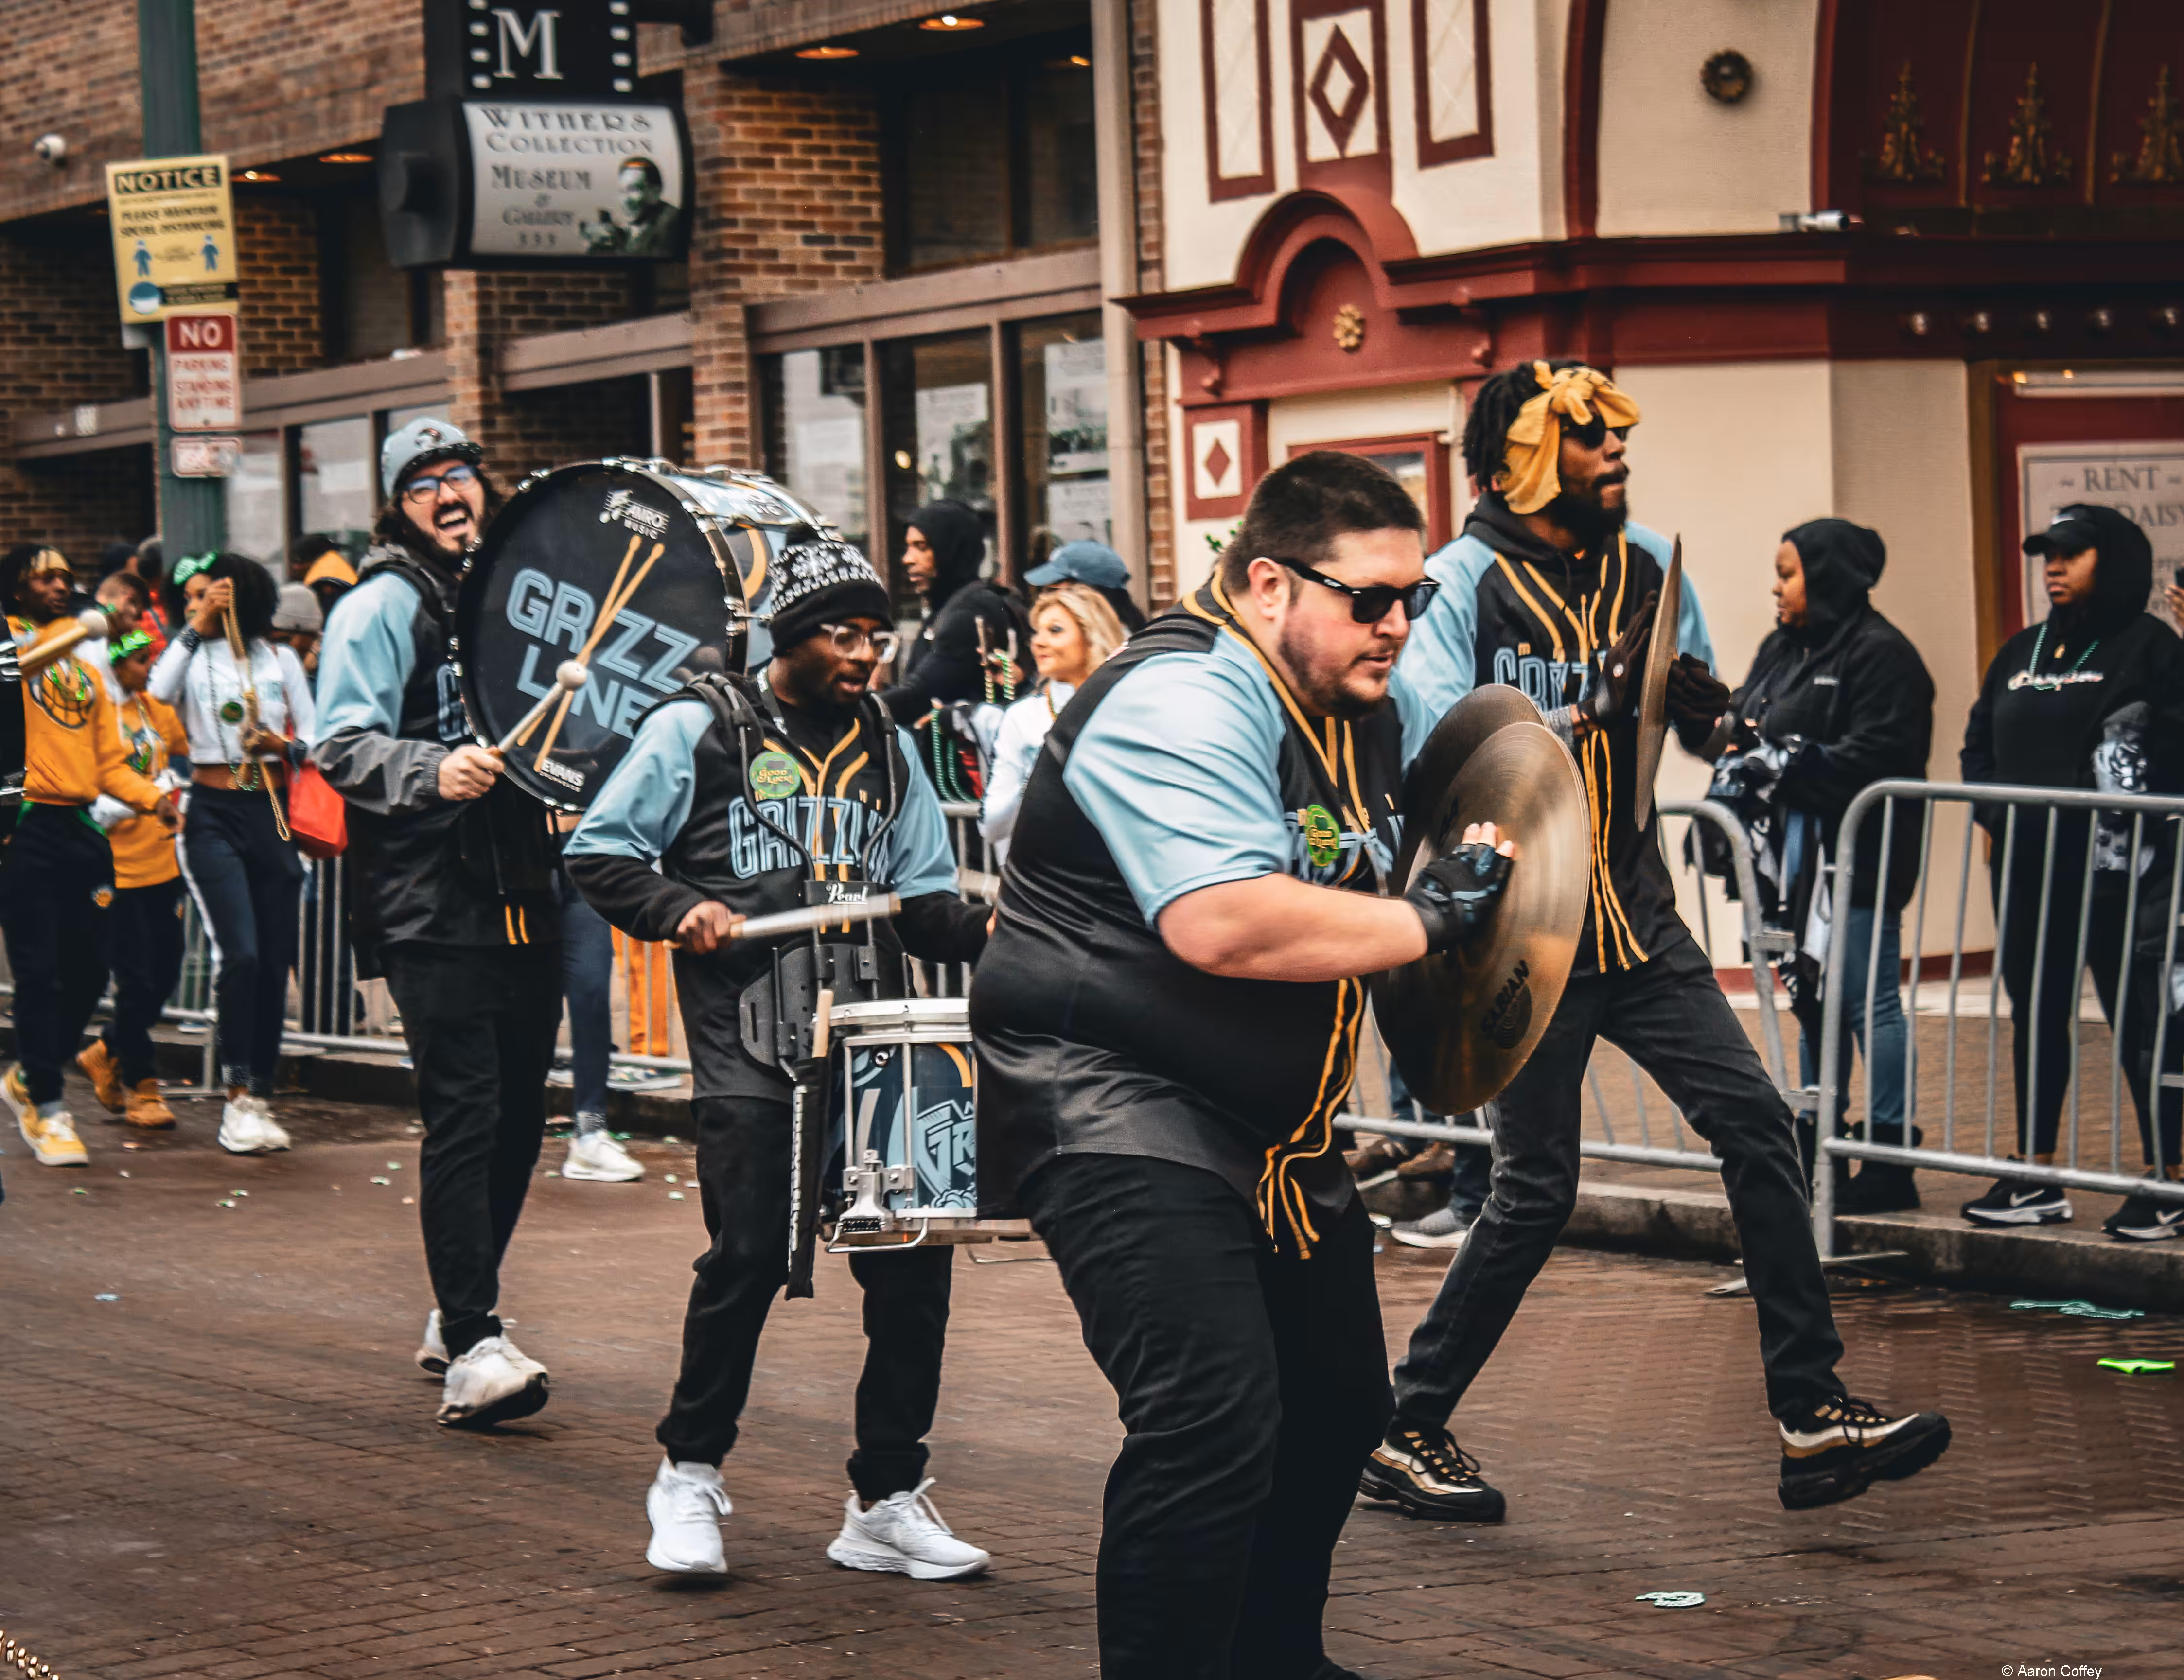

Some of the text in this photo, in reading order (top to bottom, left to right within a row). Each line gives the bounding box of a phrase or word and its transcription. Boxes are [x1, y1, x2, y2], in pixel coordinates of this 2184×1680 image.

[491, 8, 564, 79] M
[482, 108, 652, 133] WITHERS
[486, 132, 653, 155] COLLECTION
[117, 168, 217, 192] NOTICE
[491, 164, 592, 190] MUSEUM
[179, 321, 223, 348] NO
[173, 359, 229, 372] PARKING
[2084, 465, 2158, 491] RENT
[541, 758, 585, 787] EVANS
[826, 882, 869, 904] Pearl
